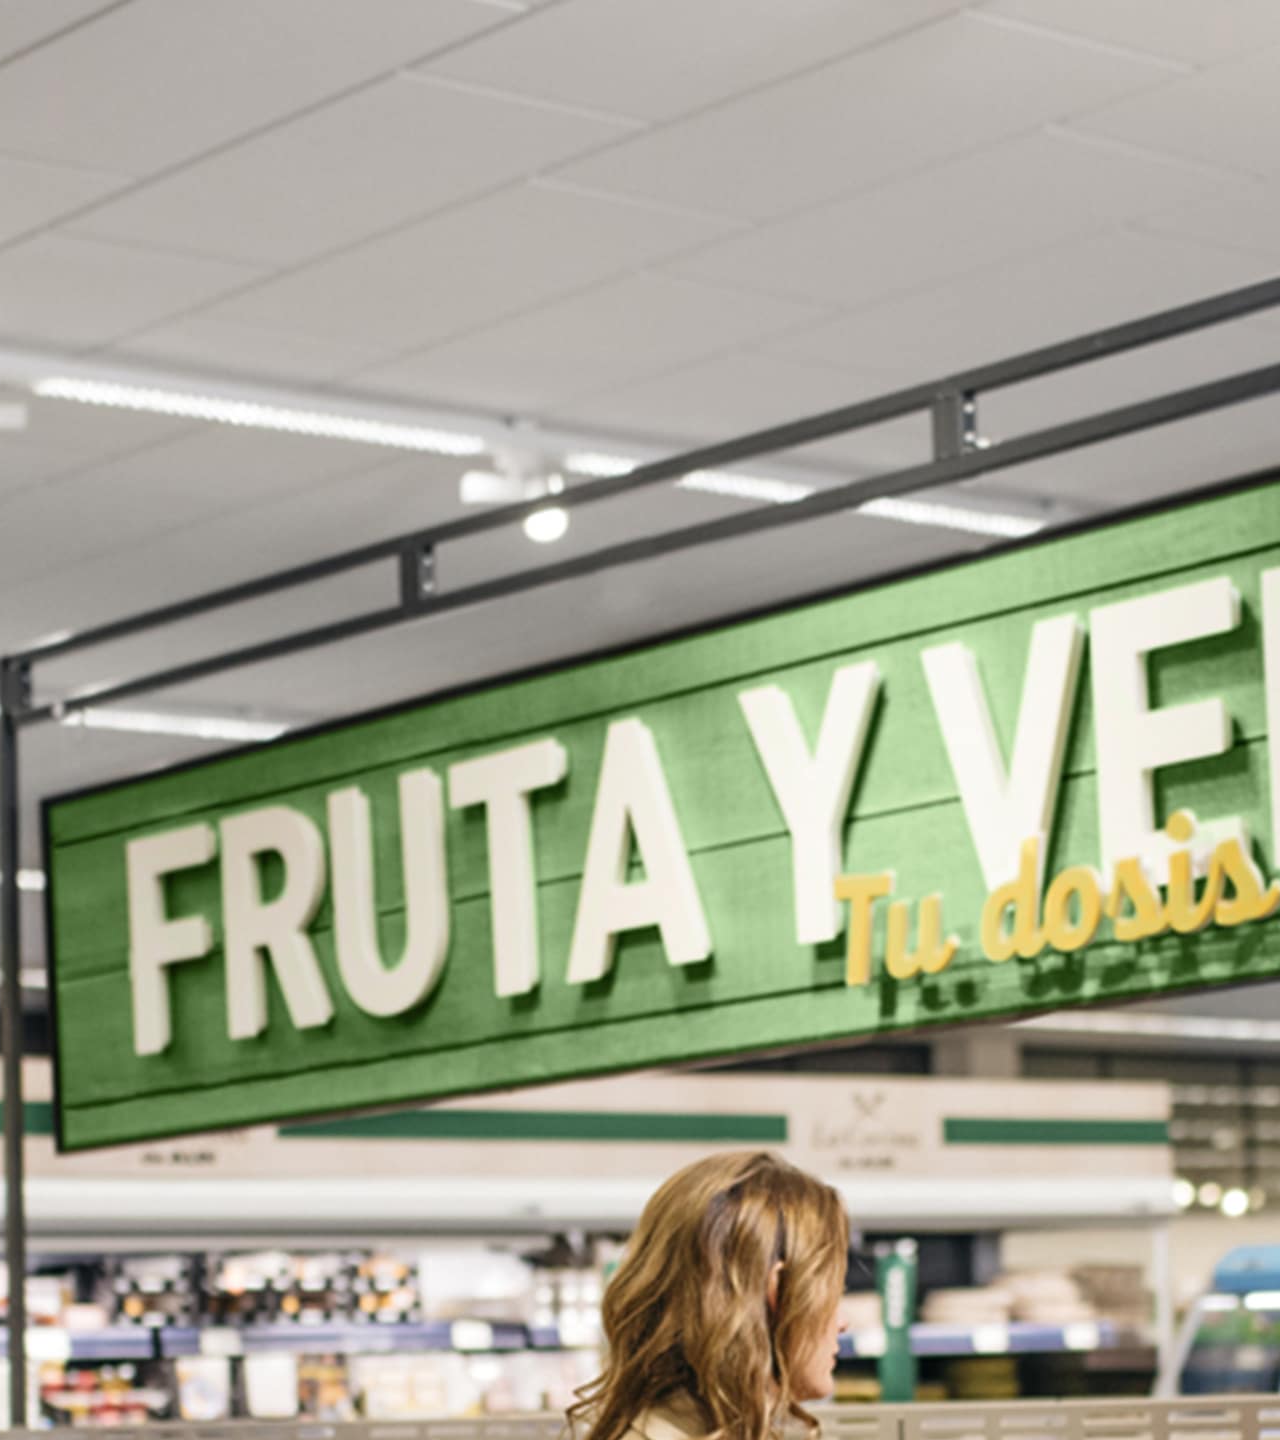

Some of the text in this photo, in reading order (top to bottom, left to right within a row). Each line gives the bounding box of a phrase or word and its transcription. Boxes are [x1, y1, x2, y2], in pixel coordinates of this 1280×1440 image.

[126, 717, 714, 1056] FRUTA
[738, 661, 882, 946] Y
[833, 870, 960, 986] Tu
